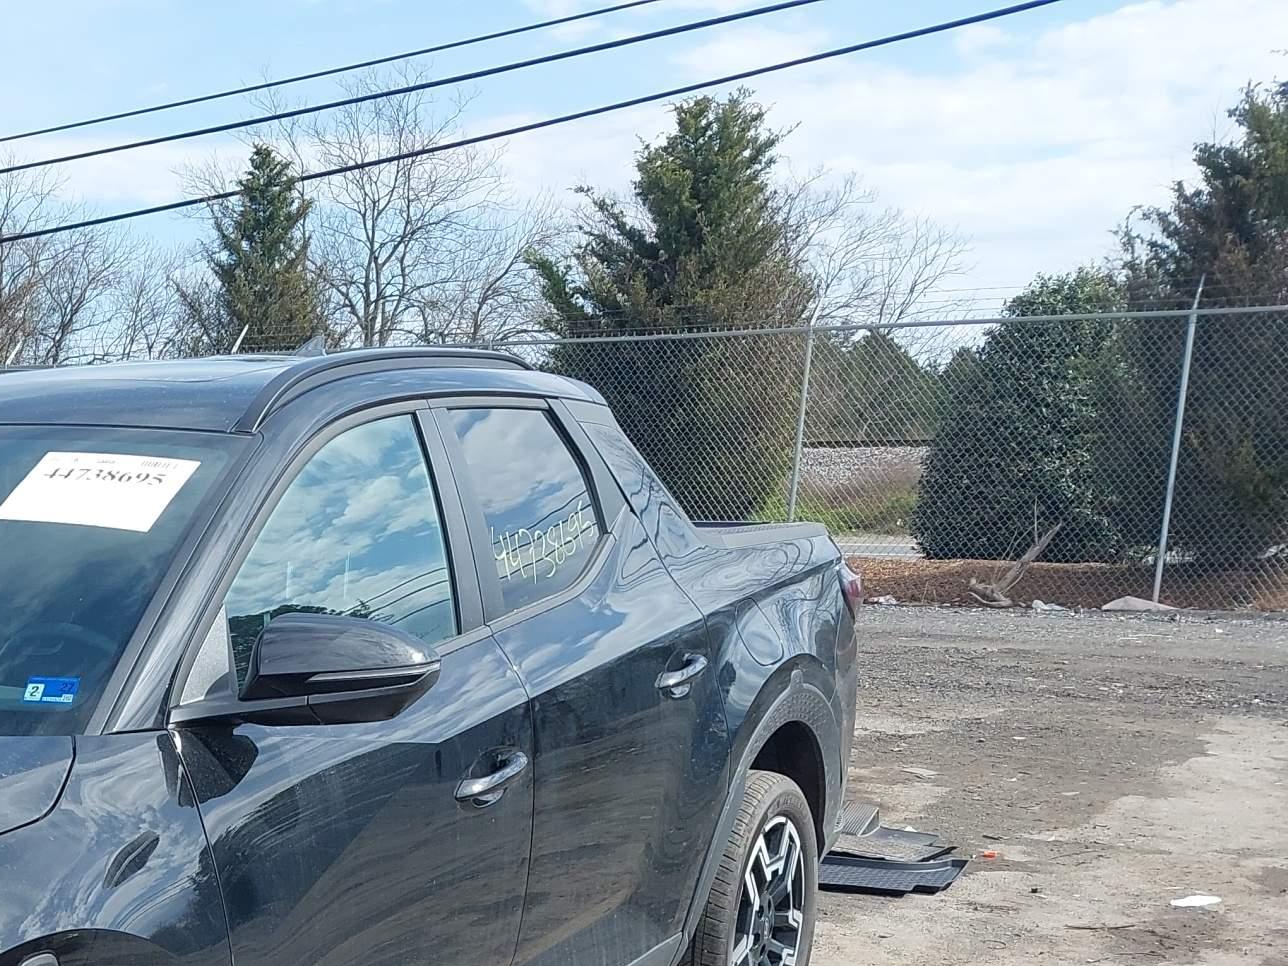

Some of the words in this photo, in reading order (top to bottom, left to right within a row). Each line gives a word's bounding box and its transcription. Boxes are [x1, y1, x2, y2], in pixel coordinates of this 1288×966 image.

[45, 468, 167, 486] 44738695
[492, 500, 593, 584] 44738695
[30, 686, 39, 697] 2
